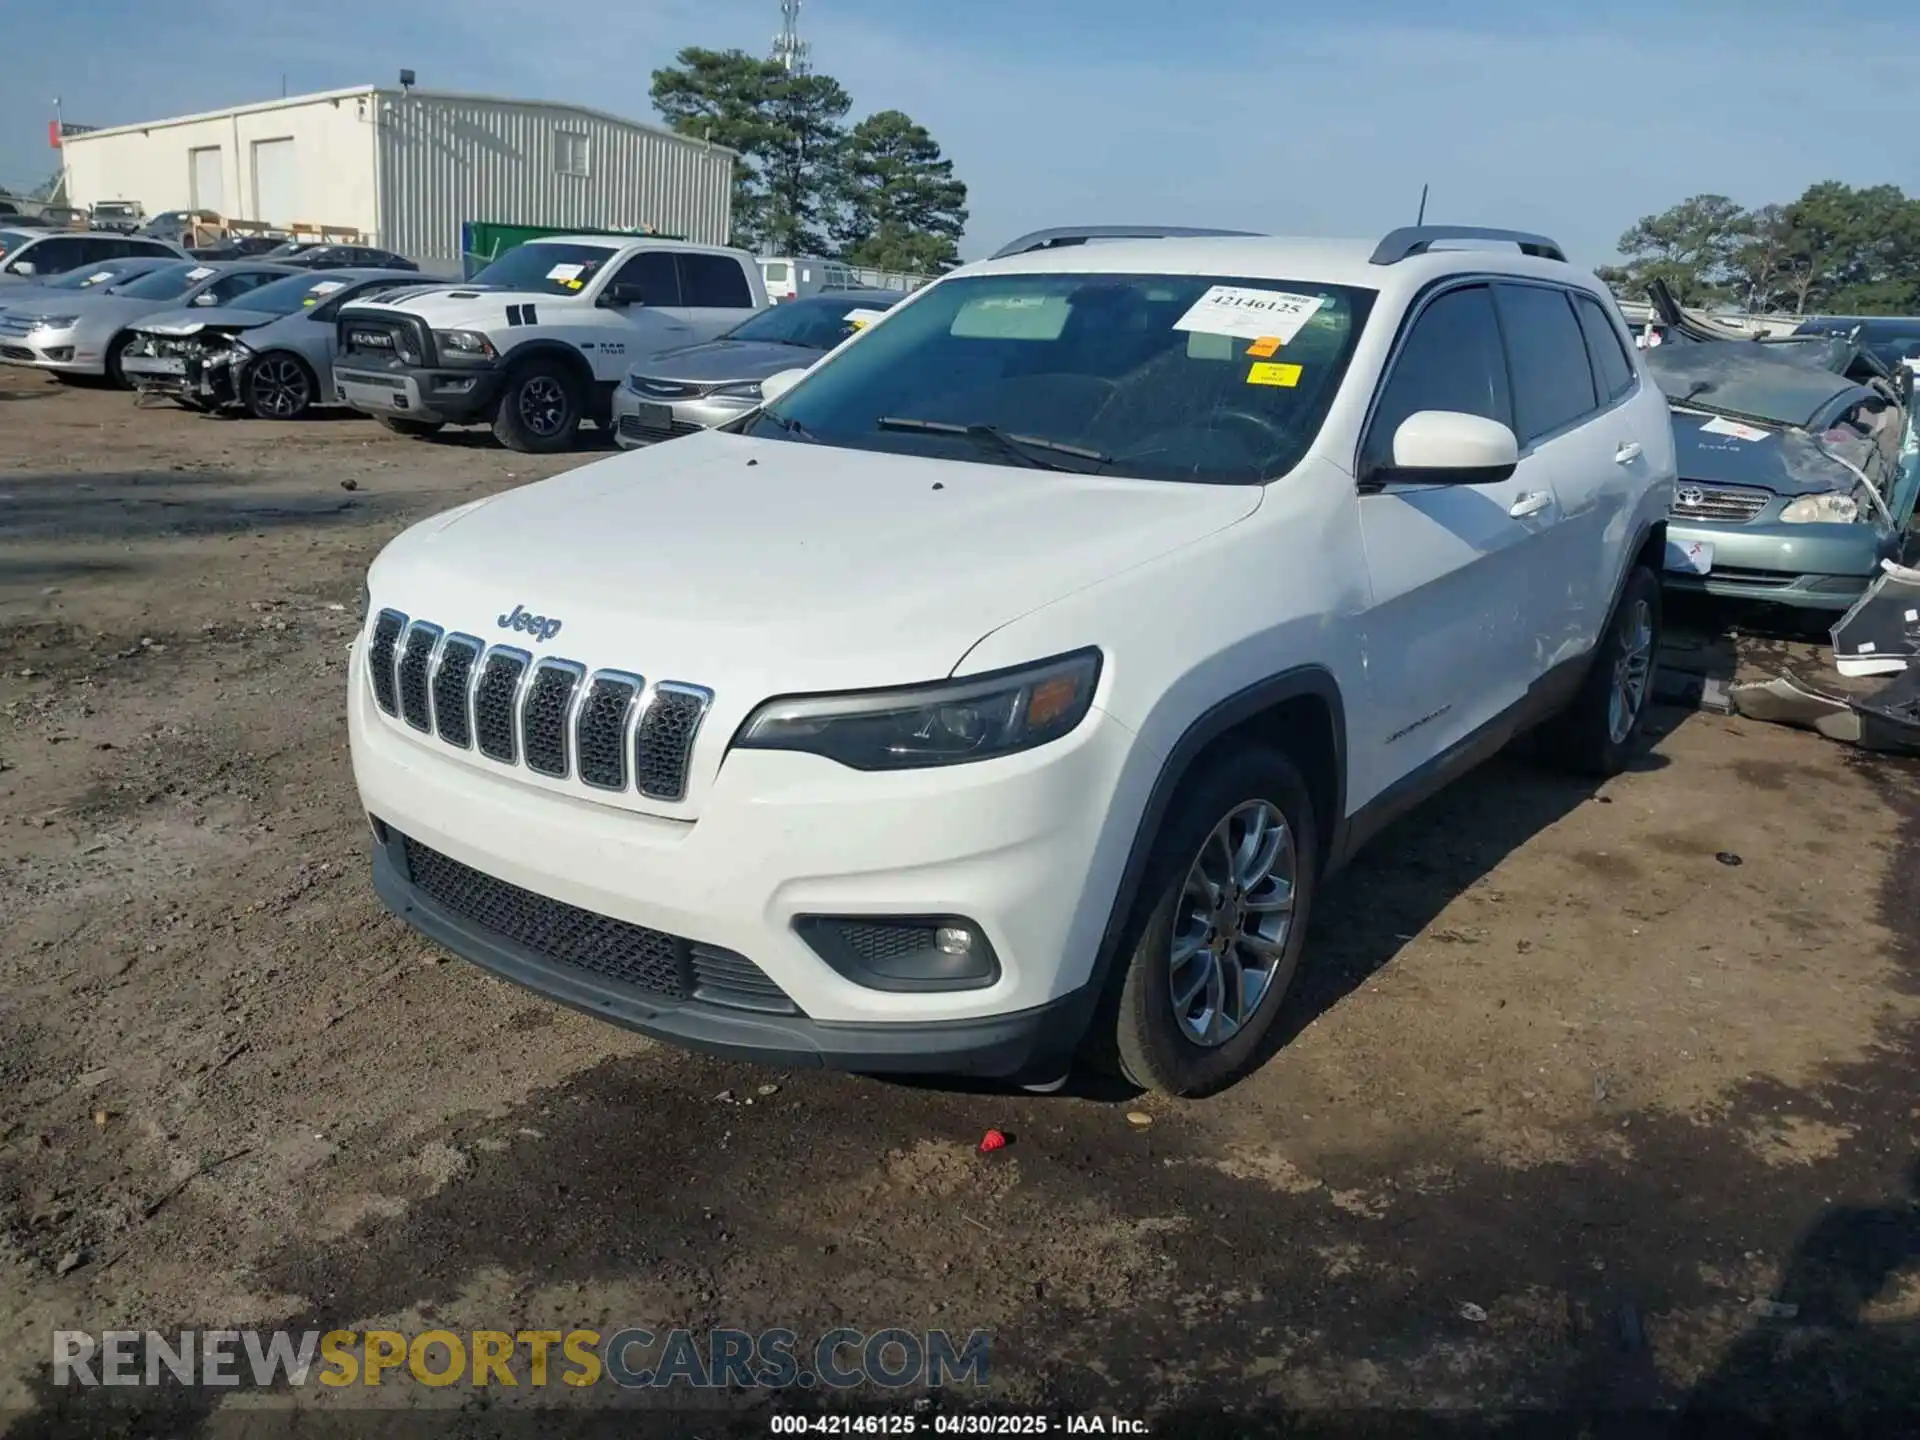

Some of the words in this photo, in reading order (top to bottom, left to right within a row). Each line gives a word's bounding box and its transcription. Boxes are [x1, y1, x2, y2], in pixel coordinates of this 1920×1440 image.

[1211, 295, 1303, 314] 42146125
[351, 333, 392, 347] RAM
[498, 604, 562, 643] Jeep
